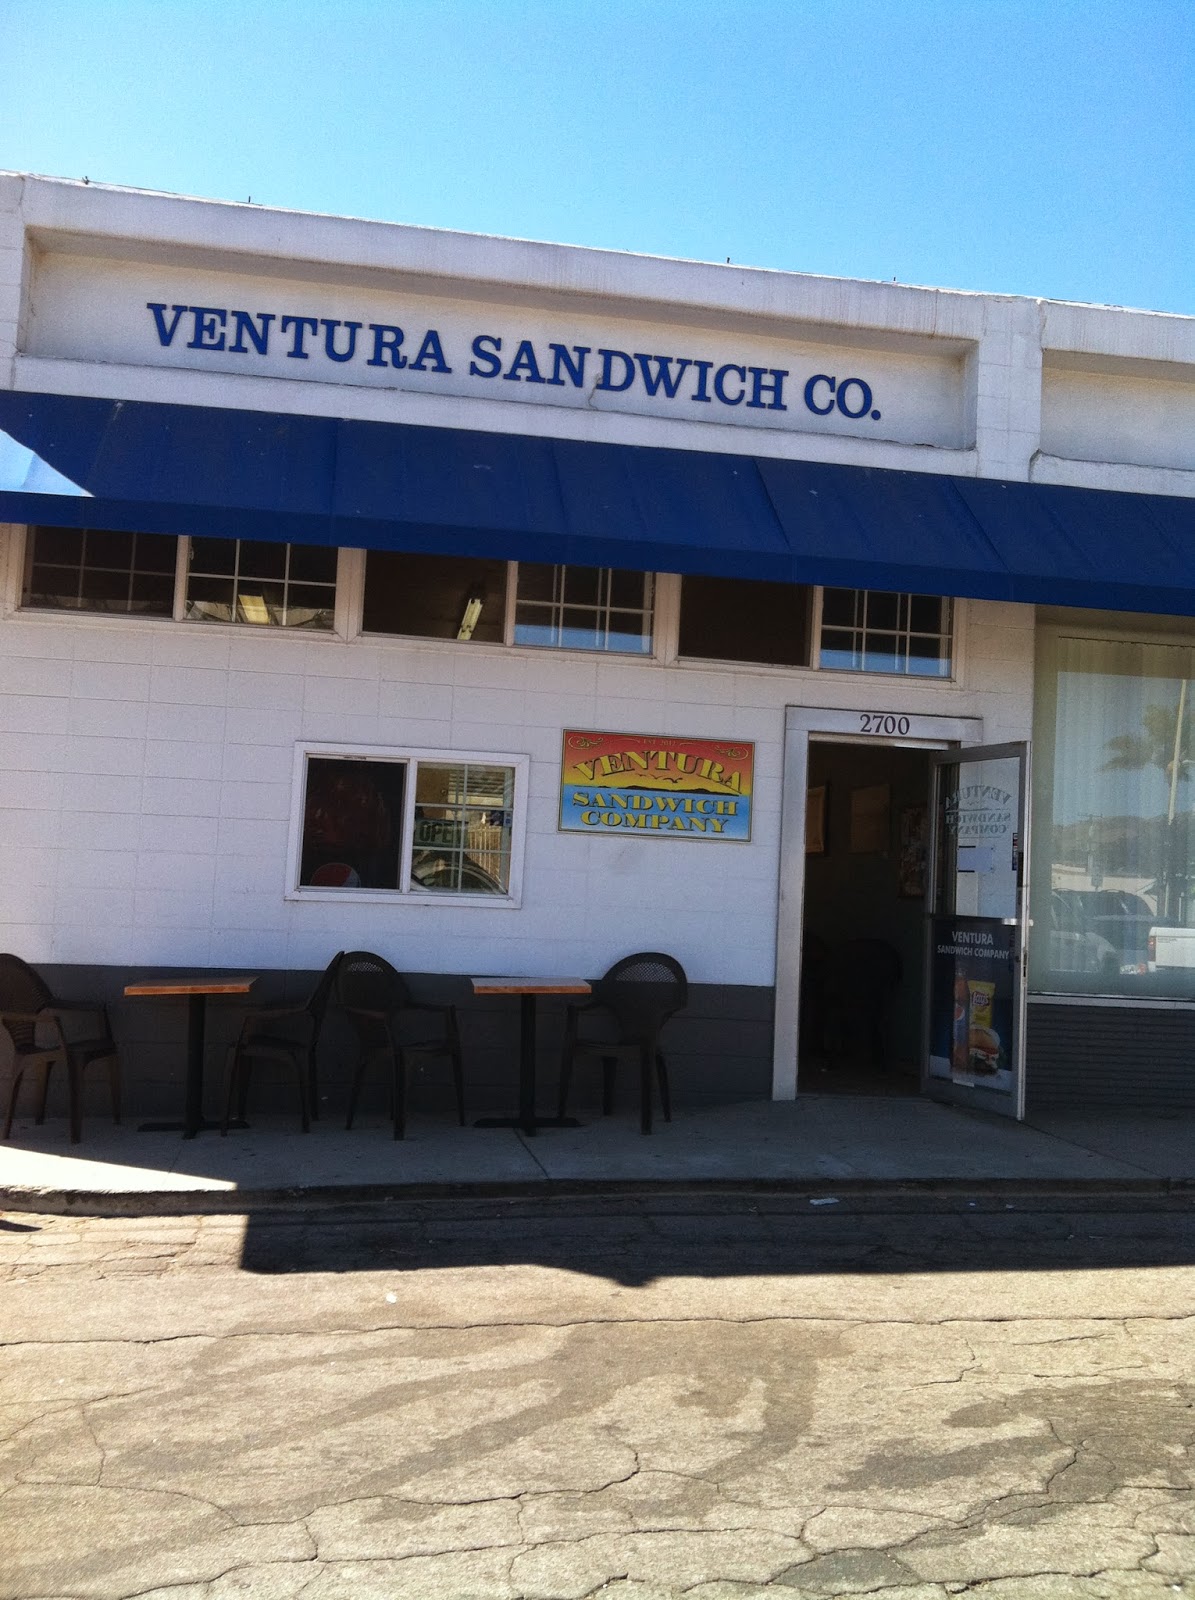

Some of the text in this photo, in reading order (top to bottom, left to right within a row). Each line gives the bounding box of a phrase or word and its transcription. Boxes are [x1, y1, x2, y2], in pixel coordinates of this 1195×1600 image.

[146, 302, 882, 421] VENTURA SANDWICH CO.
[859, 713, 911, 735] 2700
[573, 750, 743, 794] VENTURA
[572, 792, 739, 815] SANDWICH
[580, 810, 730, 833] COMPANY
[951, 931, 994, 945] VENTURA
[937, 945, 1010, 960] SANDWICH COMPANY
